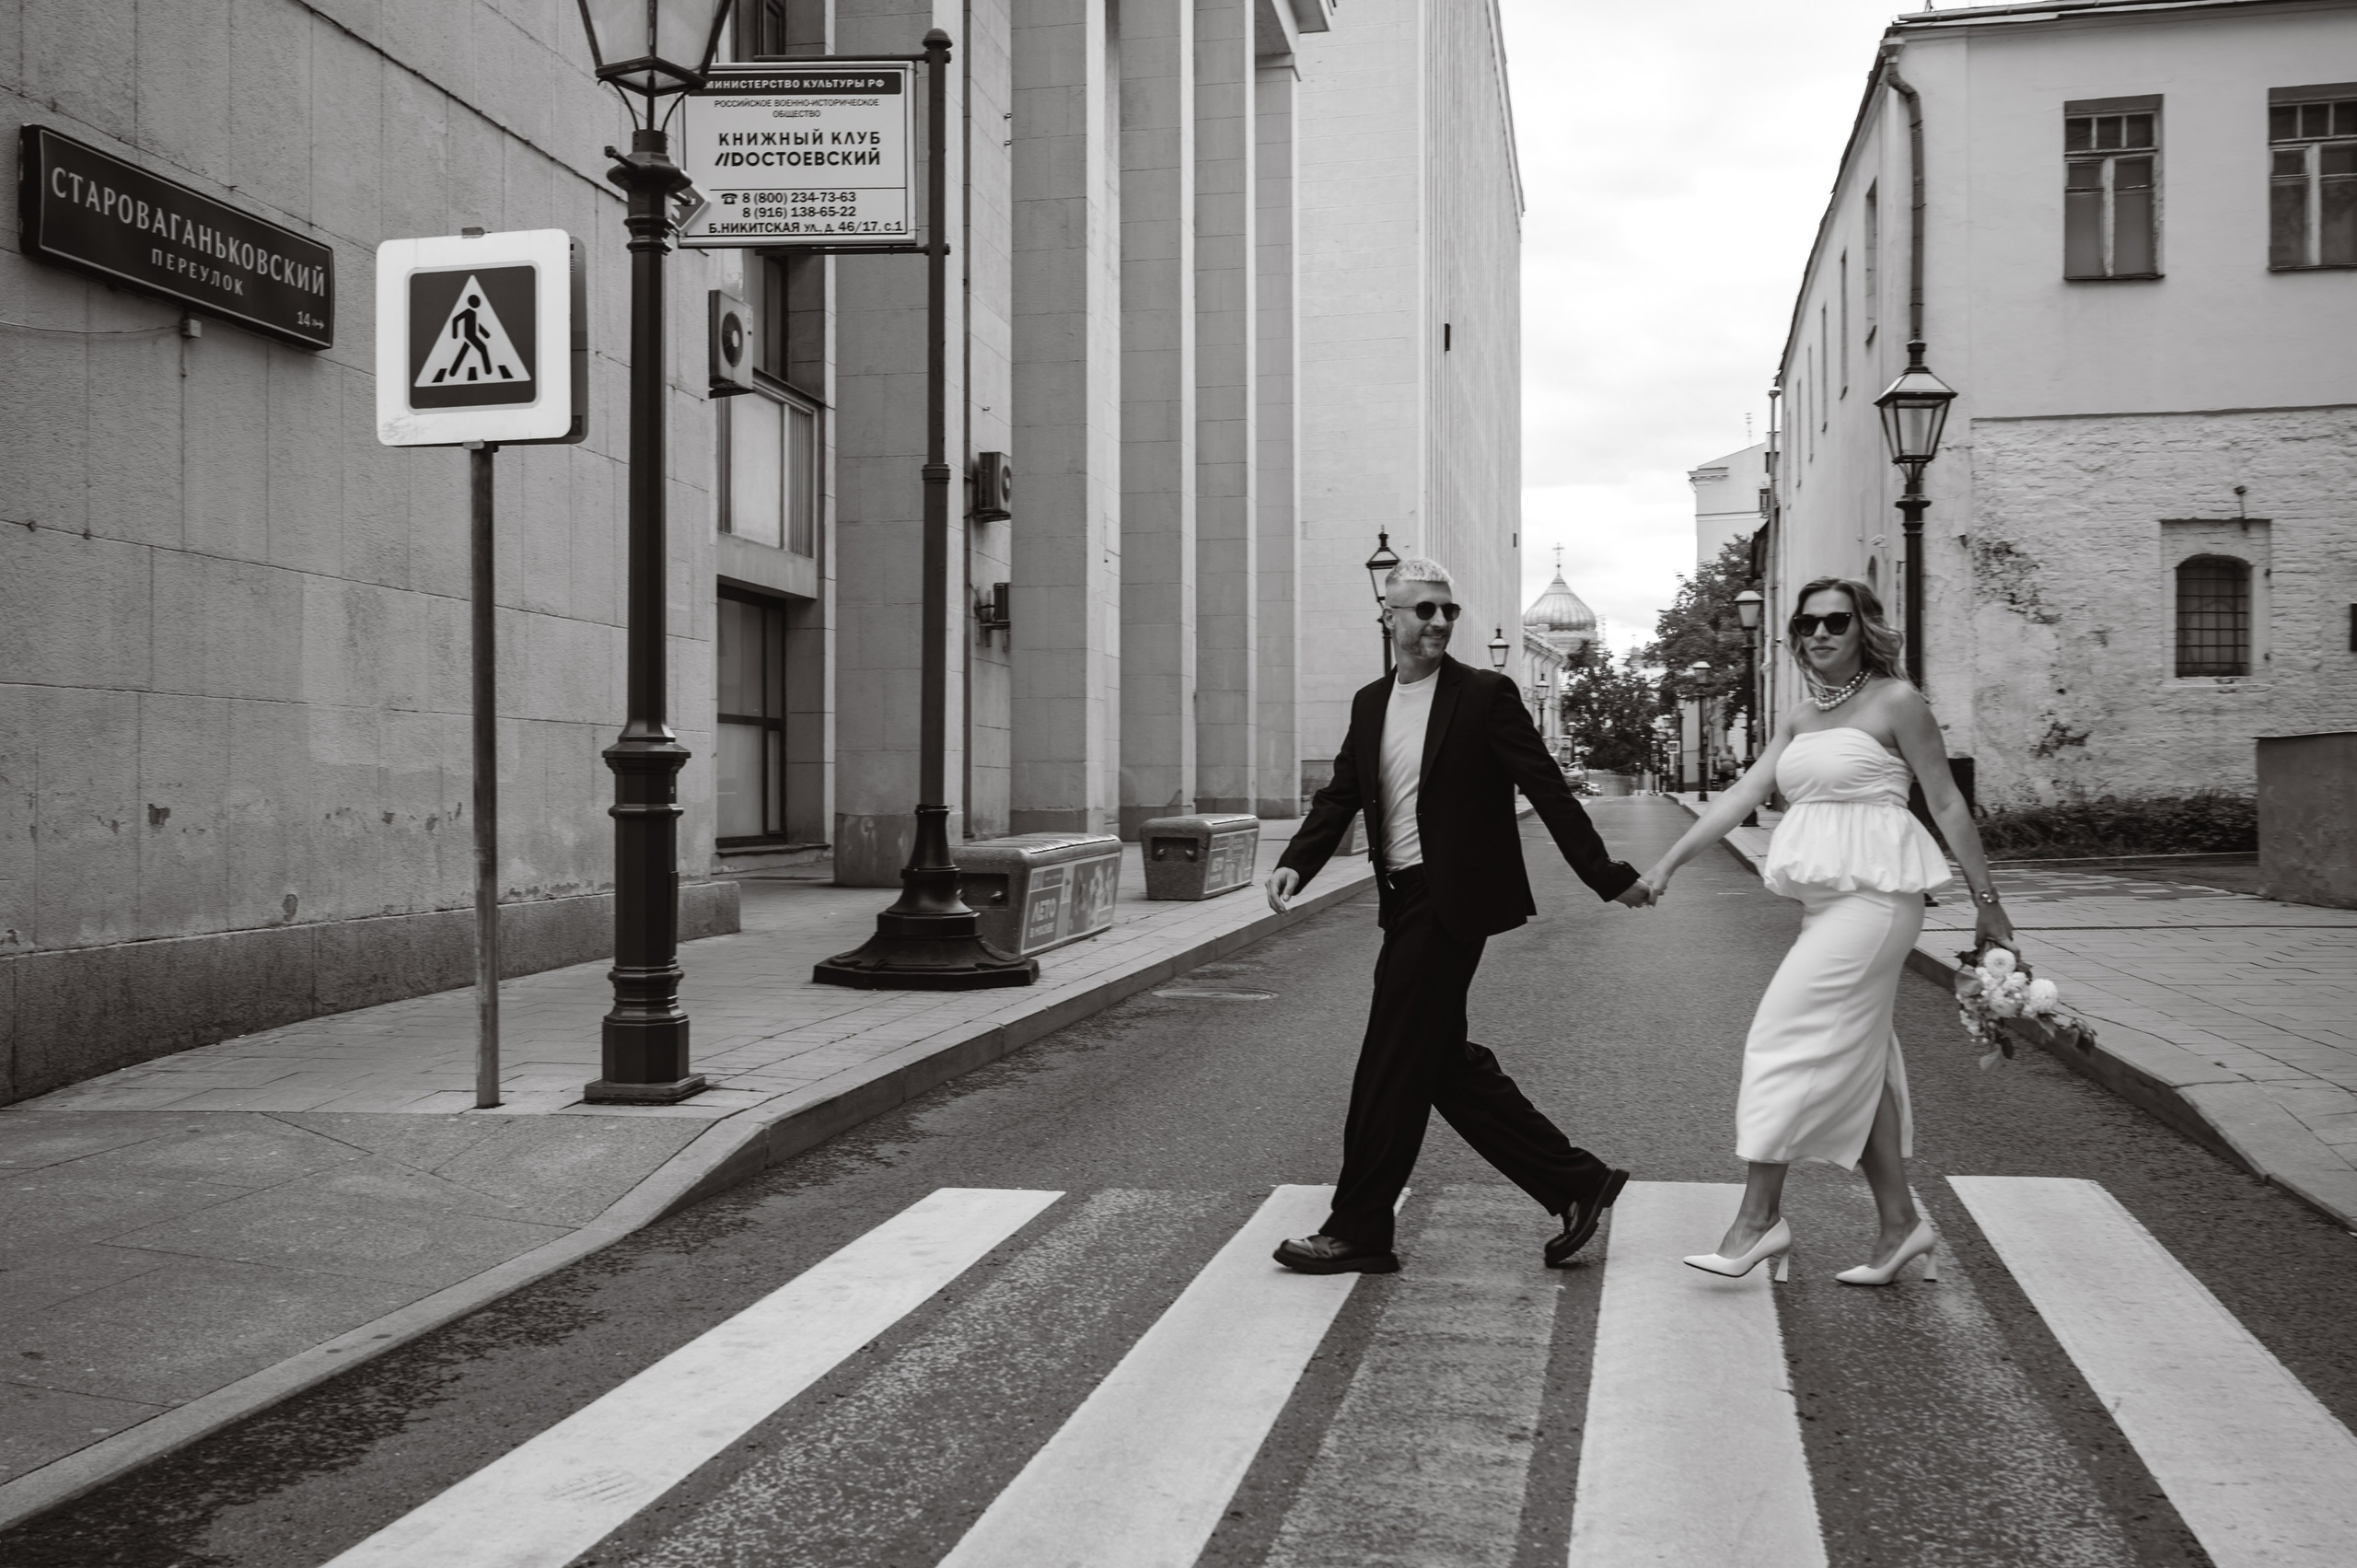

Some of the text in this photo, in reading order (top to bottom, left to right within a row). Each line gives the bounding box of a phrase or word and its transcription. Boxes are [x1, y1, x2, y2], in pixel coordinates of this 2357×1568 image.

[803, 79, 865, 88] КУЛЬТУРЫ
[867, 78, 885, 87] РФ
[714, 98, 879, 108] РОССИЙСКОЕ ВОЕННО-ИСТОРИЧЕСКОЕ
[772, 110, 821, 118] ОБЩЕСТВО
[718, 128, 881, 146] КНИЖНЫЙ КЛУБ
[742, 192, 856, 205] 8 (800) 234-73-63
[742, 206, 856, 220] 8 (916) 138-65-22
[52, 166, 325, 296] СТАРОВАГАНЬКОВСКИЙ
[708, 222, 800, 234] Б.НИКИТСКАЯ
[151, 248, 244, 296] ПЕРЕУЛОК
